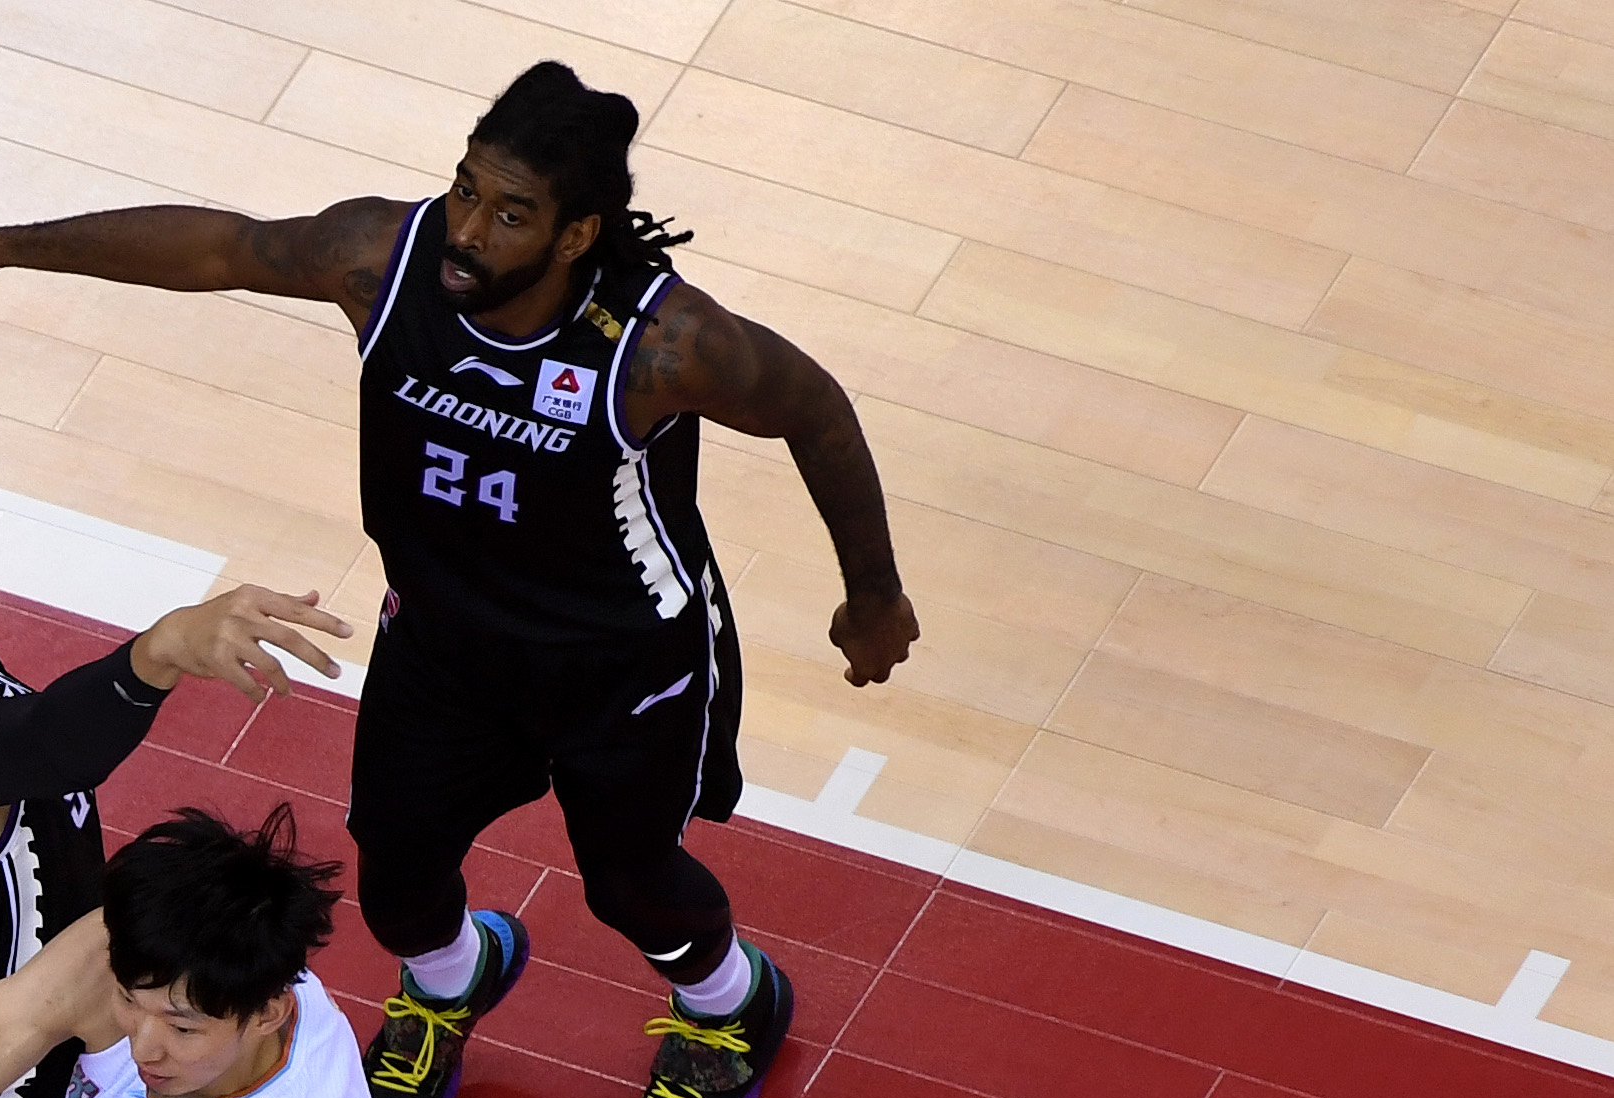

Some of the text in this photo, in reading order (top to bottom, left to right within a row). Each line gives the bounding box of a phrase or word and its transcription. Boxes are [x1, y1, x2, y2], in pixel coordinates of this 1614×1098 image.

[393, 374, 577, 454] LIAONING
[548, 407, 572, 420] CGB
[422, 440, 519, 524] 24
